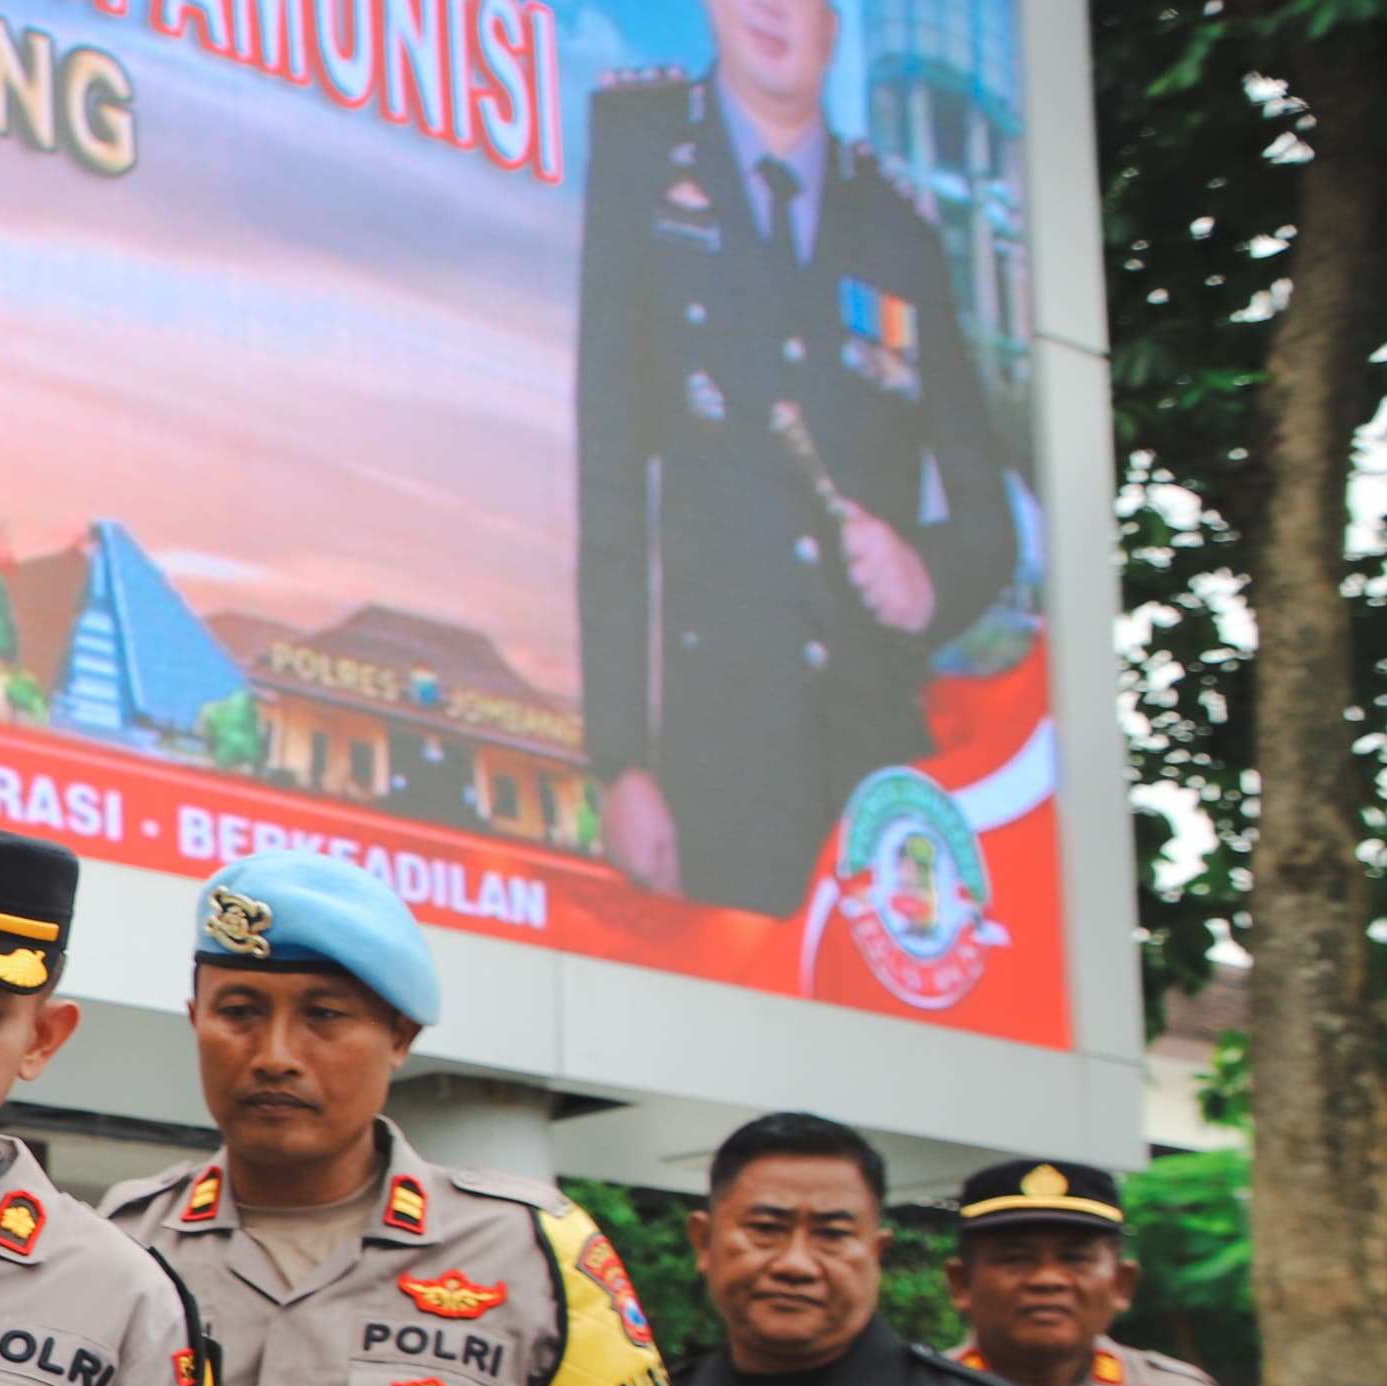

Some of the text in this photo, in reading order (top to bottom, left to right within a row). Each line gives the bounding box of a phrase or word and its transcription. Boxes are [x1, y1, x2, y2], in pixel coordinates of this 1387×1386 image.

[149, 0, 563, 185] UNISI
[269, 642, 400, 703] POLRES
[361, 1322, 506, 1378] POLRI
